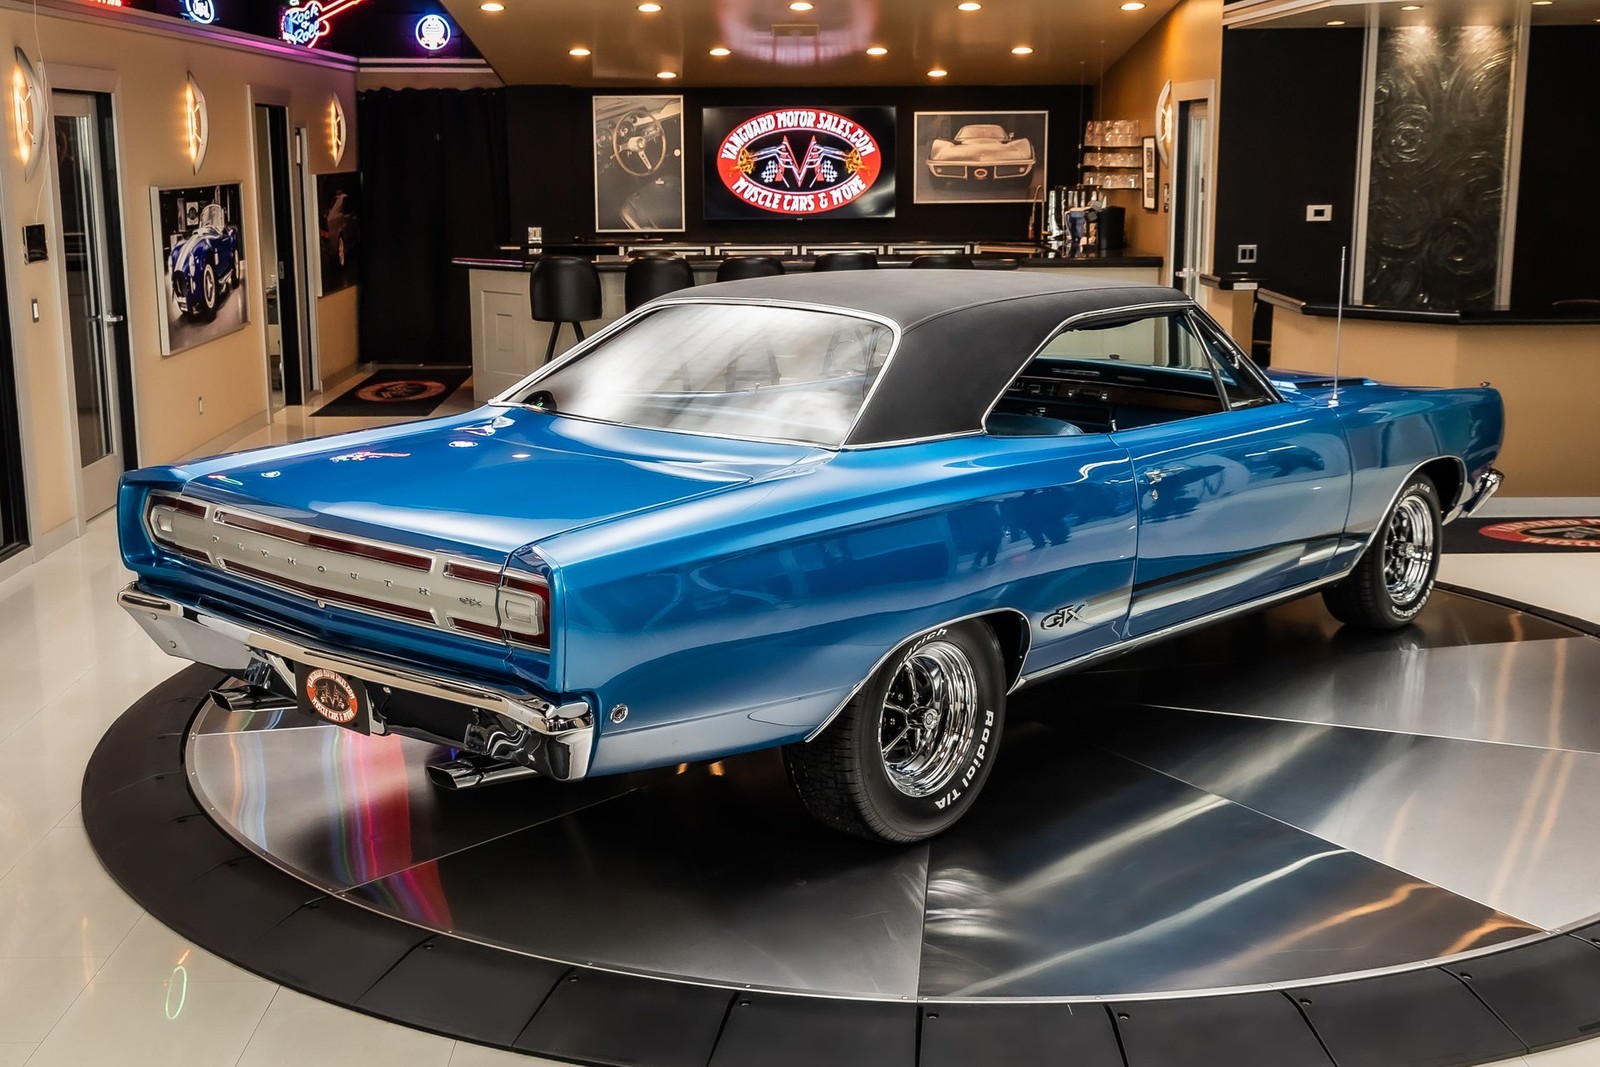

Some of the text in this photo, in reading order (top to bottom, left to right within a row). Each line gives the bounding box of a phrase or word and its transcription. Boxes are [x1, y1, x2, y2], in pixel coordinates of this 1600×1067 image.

[289, 3, 319, 25] Rock
[294, 20, 319, 44] Roll
[721, 110, 876, 161] VANGUARD MOTOR SALES.COM
[731, 174, 867, 212] MUSCLE CARS & MORE
[213, 535, 431, 596] PLYMOUTH
[1040, 604, 1085, 630] GTX
[934, 709, 994, 810] Radial T/A
